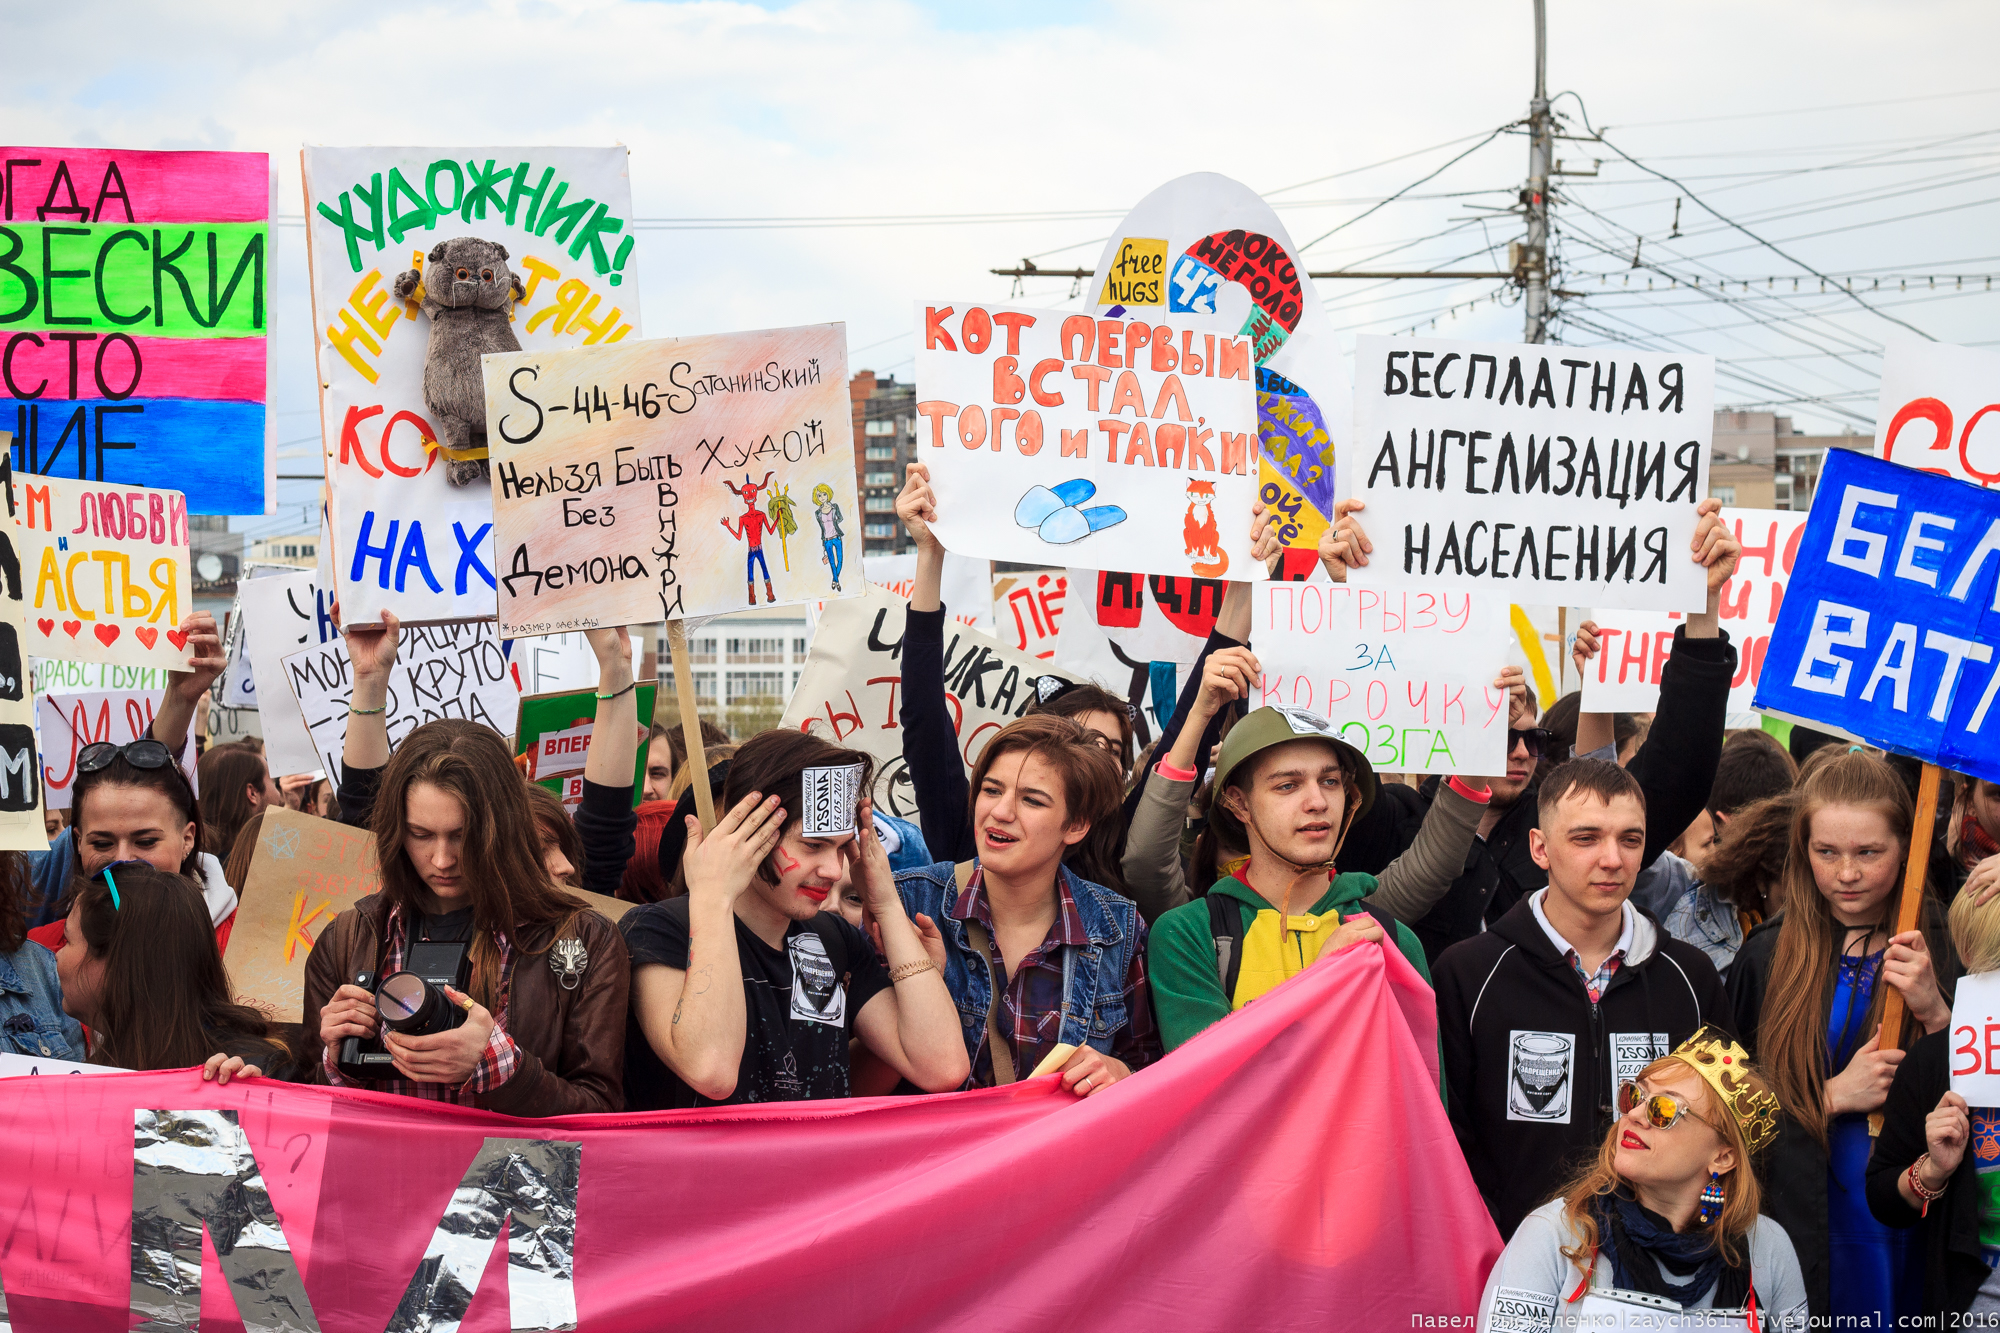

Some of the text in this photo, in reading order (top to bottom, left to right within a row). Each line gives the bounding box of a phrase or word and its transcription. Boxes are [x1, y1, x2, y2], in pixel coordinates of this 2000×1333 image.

[0, 159, 135, 223] ГДА
[316, 158, 635, 287] ХУДОЖНИК!
[1116, 243, 1163, 278] free
[327, 268, 402, 385] НЕ
[925, 306, 1037, 355] КОТ
[1060, 315, 1250, 381] ПЕРВЫЙ
[1384, 351, 1684, 415] БЕСПЛАТНАЯ
[916, 400, 1044, 457] ТОГО
[1098, 419, 1259, 477] ТАПКИ!
[1367, 428, 1700, 509] АНГЕЛИЗАЦИЯ
[499, 461, 600, 499] Нельзя
[615, 446, 683, 486] Быть
[563, 498, 616, 528] Без
[502, 543, 650, 598] Демона
[1404, 520, 1668, 584] НАСЕЛЕНИЯ
[1270, 585, 1470, 634] ПОГРЫЗУ
[407, 640, 505, 707] КРУТО
[1345, 643, 1396, 671] ЗА
[1261, 673, 1505, 728] КОРОЧКУ
[816, 770, 830, 831] 2SOMA
[833, 769, 843, 830] 03.05.2016
[1497, 1300, 1549, 1320] 2SOMA
